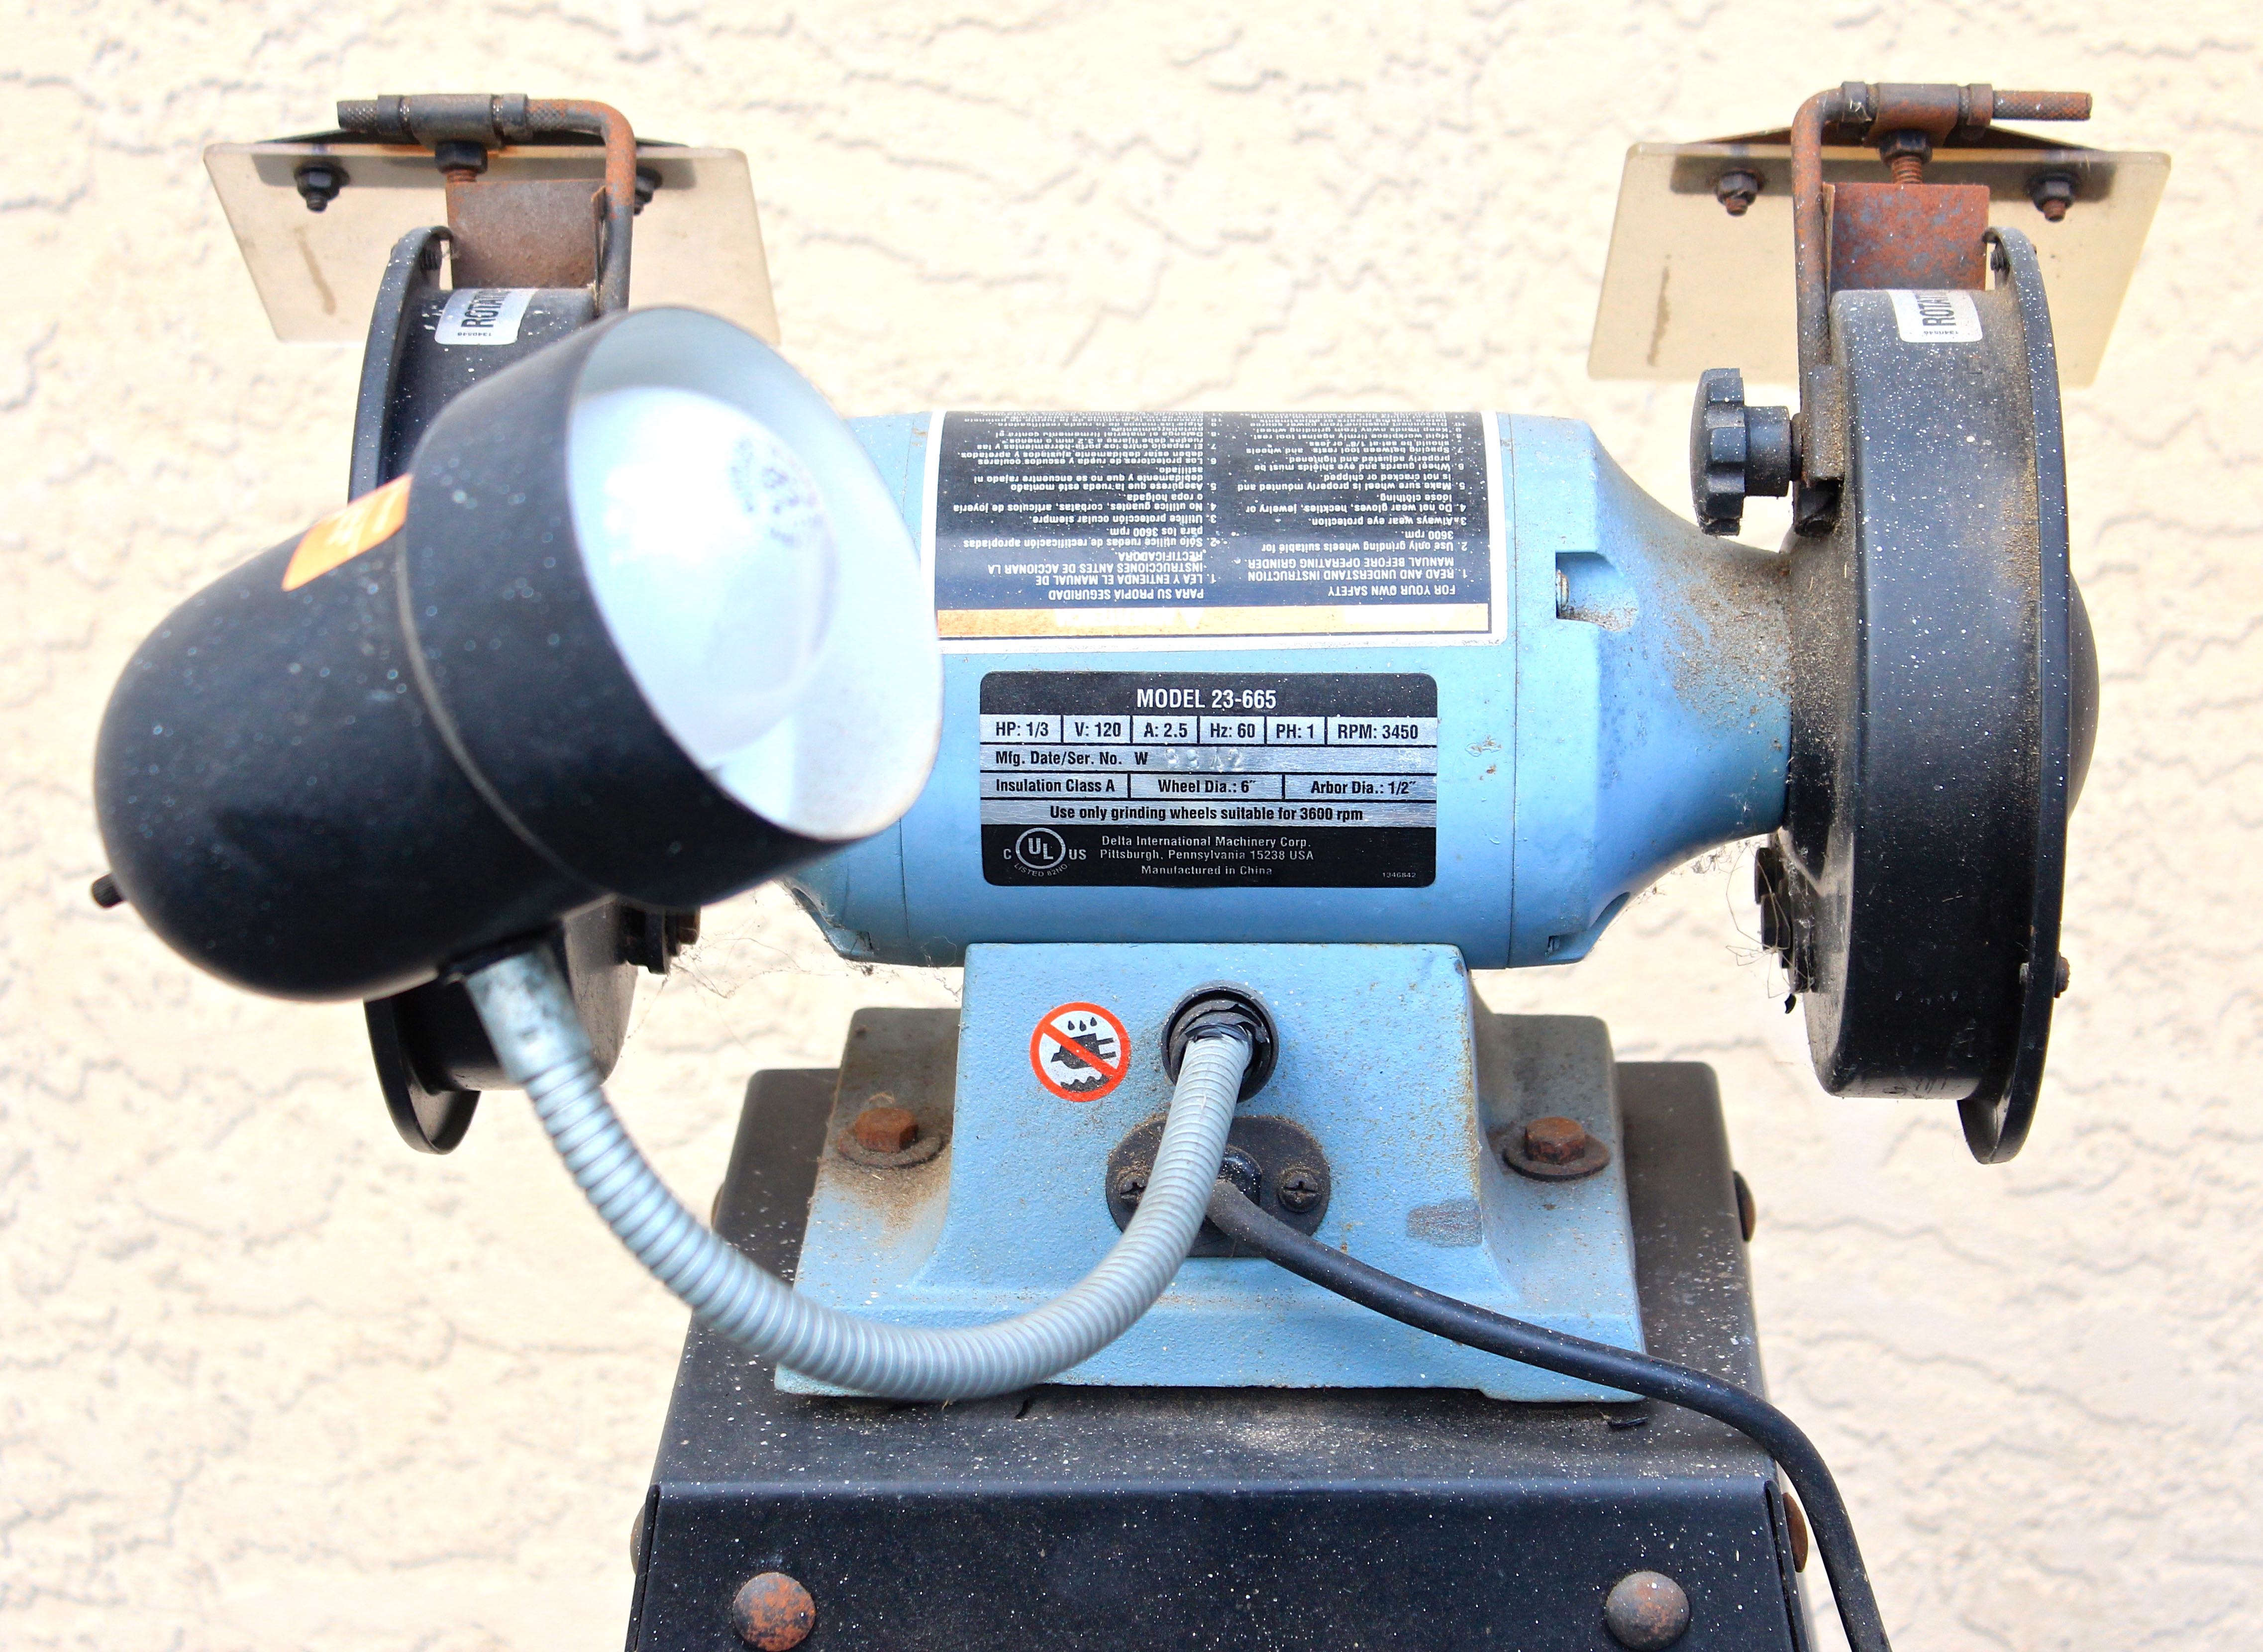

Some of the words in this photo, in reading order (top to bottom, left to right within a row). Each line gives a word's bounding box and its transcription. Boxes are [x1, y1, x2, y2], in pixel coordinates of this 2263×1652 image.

[1321, 472, 1363, 482] chipped.
[1238, 483, 1256, 492] and
[1308, 481, 1349, 491] properly
[1423, 482, 1451, 491] Make
[1125, 492, 1167, 502] holgada.
[1170, 491, 1194, 500] ropa
[1377, 493, 1421, 502] clothing.
[1425, 494, 1452, 502] loose
[954, 502, 988, 513] joyería
[992, 504, 1004, 512] de
[1008, 503, 1052, 512] artículos
[1056, 502, 1103, 512] corbatas,
[1107, 501, 1150, 511] guantes,
[1154, 503, 1186, 511] utilice
[1189, 503, 1203, 511] No
[1207, 503, 1217, 511] 4.
[1260, 503, 1297, 514] jewelry
[1351, 503, 1387, 513] gloves,
[1419, 504, 1436, 513] not
[1440, 504, 1452, 513] Do
[1029, 514, 1074, 524] siempre.
[1077, 515, 1110, 524] ocular
[1113, 514, 1166, 524] protección
[1170, 515, 1203, 523] Utilice
[1309, 516, 1363, 527] protection.
[1367, 516, 1385, 524] eye
[1416, 516, 1452, 526] Always
[1107, 526, 1130, 535] rpm.
[1133, 527, 1158, 536] 3600
[1161, 527, 1177, 536] los
[1180, 526, 1203, 535] para
[1402, 529, 1425, 539] rpm.
[1428, 530, 1453, 540] 3600
[964, 537, 1021, 548] apropiadas
[1025, 538, 1087, 548] rectificación
[1091, 538, 1103, 547] de
[1107, 538, 1141, 547] ruedas
[1144, 538, 1176, 547] utilice
[1207, 537, 1216, 546] 2.
[1363, 541, 1405, 552] grinding
[1409, 540, 1431, 552] only
[1435, 542, 1453, 551] Use
[1457, 541, 1467, 551] 2.
[1261, 543, 1276, 553] for
[1279, 543, 1321, 553] suitable
[1324, 543, 1359, 552] wheels
[1115, 551, 1203, 561] RECTIFICADORA.
[1245, 559, 1296, 569] GRINDER.
[1300, 558, 1360, 568] OPERATING
[1364, 557, 1405, 567] BEFORE
[1409, 557, 1454, 567] MANUAL
[988, 565, 1001, 574] LA
[1005, 564, 1058, 574] ACCIONAR
[1063, 564, 1075, 573] DE
[1079, 563, 1113, 573] ANTES
[1117, 563, 1203, 573] INSTRUCCIONES
[1173, 574, 1180, 583] Y
[1207, 574, 1216, 583] 1.
[1248, 570, 1320, 581] INSTRUCTION
[1324, 569, 1396, 580] UNDERSTAND
[1400, 569, 1422, 579] AND
[1426, 568, 1454, 579] READ
[1036, 575, 1049, 585] DE
[1053, 575, 1098, 585] MANUAL
[1101, 575, 1113, 584] EL
[1117, 574, 1170, 584] ENTIENDA
[1048, 590, 1111, 600] SEGURIDAD
[1114, 589, 1154, 599] PROPIA
[1158, 589, 1171, 599] SU
[1176, 588, 1203, 598] PARA
[1328, 586, 1367, 597] SAFETY
[1372, 585, 1396, 596] OWN
[1401, 585, 1431, 596] YOUR
[1435, 585, 1455, 595] FOR
[1136, 689, 1206, 709] MODEL
[1212, 689, 1277, 709] 23-665
[995, 723, 1021, 736] HP:
[1027, 723, 1049, 737] 1/3
[1075, 723, 1090, 736] V:
[1095, 723, 1121, 737] 120
[1144, 723, 1158, 737] A:
[1164, 723, 1188, 737] 2.5
[1210, 723, 1233, 738] Hz:
[1237, 723, 1255, 738] 60
[1276, 724, 1302, 738] PH:
[1307, 724, 1314, 738] 1
[1337, 724, 1377, 738] RPM:
[1382, 724, 1418, 739] 3450
[995, 750, 1026, 766] Mfg.
[1030, 750, 1094, 764] Date/Ser.
[1099, 750, 1122, 765] No.
[1134, 752, 1148, 765] W
[996, 778, 1062, 792] Insulation
[1065, 778, 1102, 792] Class
[1105, 779, 1114, 792] A
[1158, 779, 1200, 792] Wheel
[1205, 779, 1236, 792] Dia.:
[1311, 780, 1347, 794] Arbor
[1352, 780, 1384, 794] Dia.:
[1050, 806, 1075, 818] Use
[1080, 806, 1108, 821] only
[1112, 806, 1164, 821] grinding
[1169, 806, 1217, 819] wheels
[1220, 806, 1275, 820] suitable
[1278, 807, 1297, 820] for
[1300, 807, 1332, 820] 3600
[1337, 809, 1363, 823] rpm
[1103, 835, 1132, 847] Delta
[1136, 836, 1210, 847] International
[1215, 836, 1272, 849] Machinery
[1280, 836, 1311, 849] Corp.
[1003, 848, 1011, 859] C
[1028, 837, 1054, 860] UL
[1069, 849, 1087, 860] US
[1101, 848, 1164, 861] Pittsburgh,
[1168, 849, 1245, 862] Pennsylvania
[1251, 849, 1285, 860] 15238
[1290, 849, 1314, 860] USA
[1014, 863, 1044, 877] LISTED
[1141, 865, 1222, 875] Manufactured
[1225, 865, 1235, 875] in
[1239, 865, 1272, 875] China
